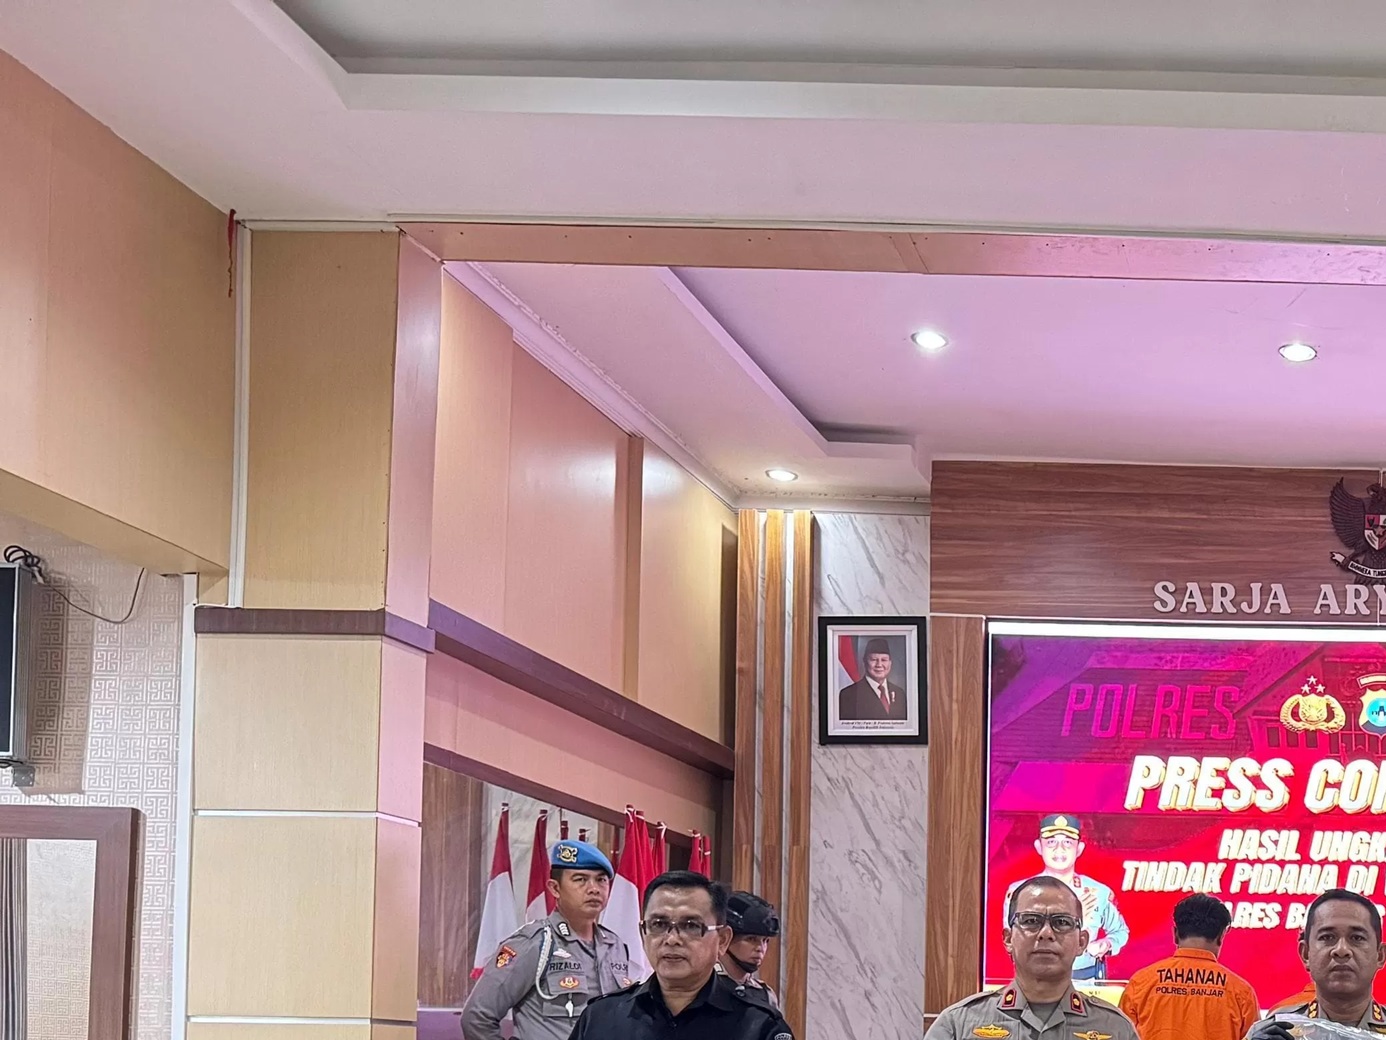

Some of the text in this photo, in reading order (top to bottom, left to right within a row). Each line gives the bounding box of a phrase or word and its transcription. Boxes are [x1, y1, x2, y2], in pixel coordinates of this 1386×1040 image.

[1153, 581, 1292, 614] SARJA
[1061, 683, 1240, 740] POLRES
[1124, 755, 1295, 813] PRESS
[1218, 829, 1301, 861] HASIL
[1121, 860, 1226, 894] TINDAK
[1230, 862, 1338, 895] PIDANA
[1345, 864, 1379, 897] DI
[1155, 986, 1224, 998] POLRES BANJAR
[1156, 967, 1227, 987] TAHANAN
